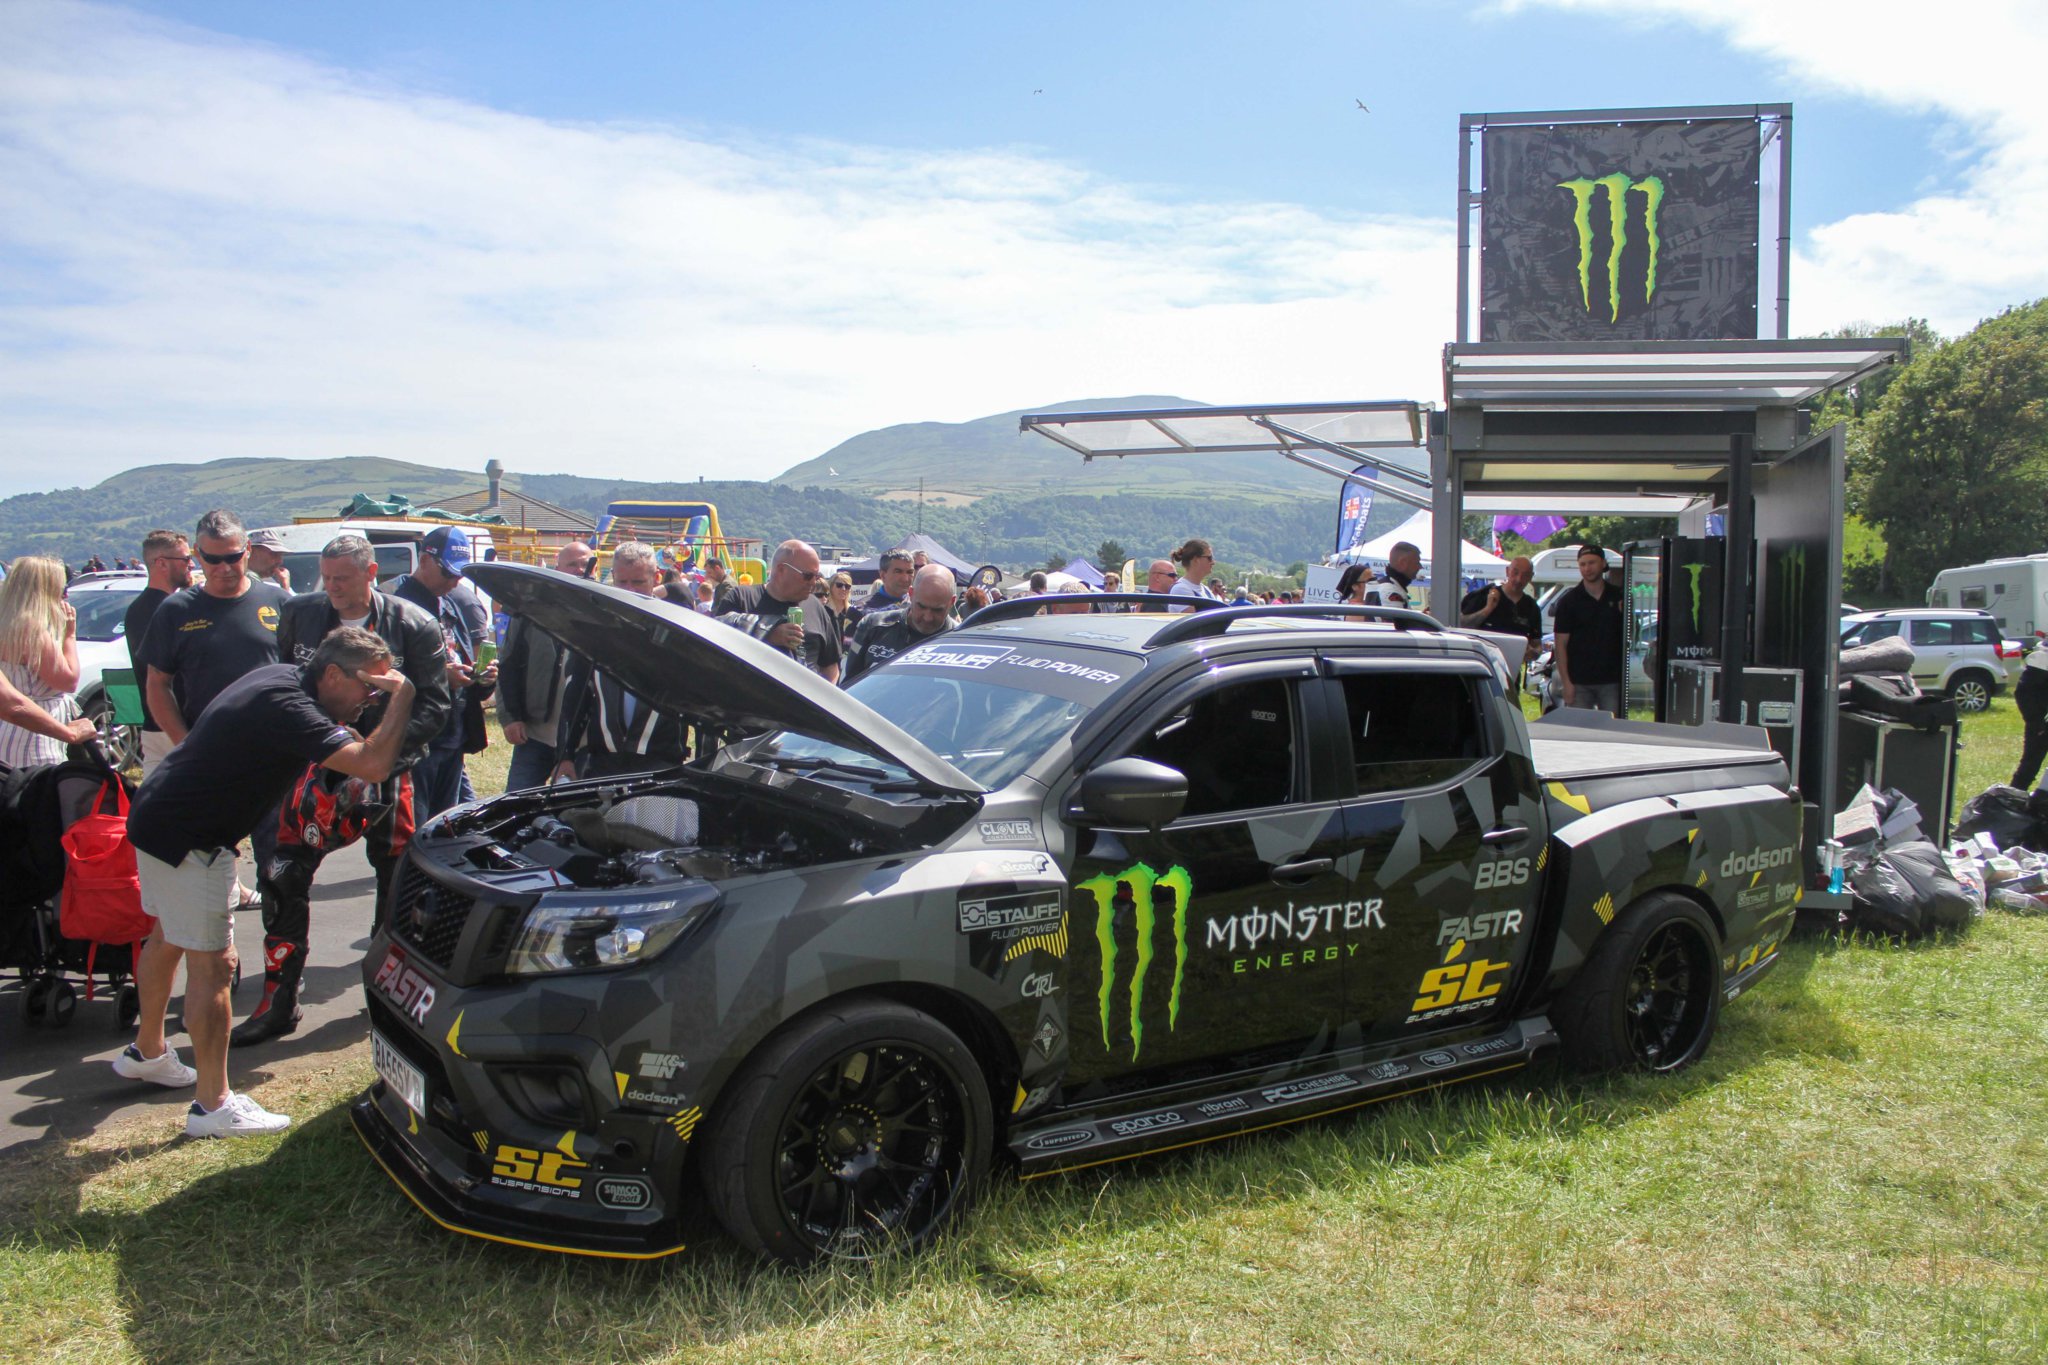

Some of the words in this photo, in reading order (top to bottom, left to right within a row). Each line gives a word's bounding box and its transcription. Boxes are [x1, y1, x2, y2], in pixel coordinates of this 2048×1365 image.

[1308, 587, 1330, 598] LIVE
[921, 652, 998, 668] STAUFF
[1000, 654, 1049, 668] FLUID
[1047, 662, 1120, 684] POWER
[980, 823, 1032, 836] CLOVER
[1720, 846, 1792, 878] dodson
[1474, 858, 1530, 890] BBS
[987, 902, 1060, 926] STAUFF
[991, 926, 1020, 941] FLUID
[1020, 922, 1059, 936] POWER
[1205, 899, 1385, 952] MONSTER
[1436, 909, 1524, 946] FASTR
[1233, 943, 1360, 974] ENERGY
[374, 946, 436, 1028] FASTR
[1020, 972, 1060, 997] CTRL
[1463, 1039, 1509, 1054] Garrett
[1298, 1073, 1350, 1090] CHESHIRE
[627, 1089, 679, 1105] dodson
[1197, 1097, 1246, 1114] vibrant
[1111, 1112, 1181, 1135] sparco
[1044, 1132, 1086, 1146] SUPERTECH
[604, 1184, 640, 1195] SAMCO
[615, 1194, 638, 1202] sport
